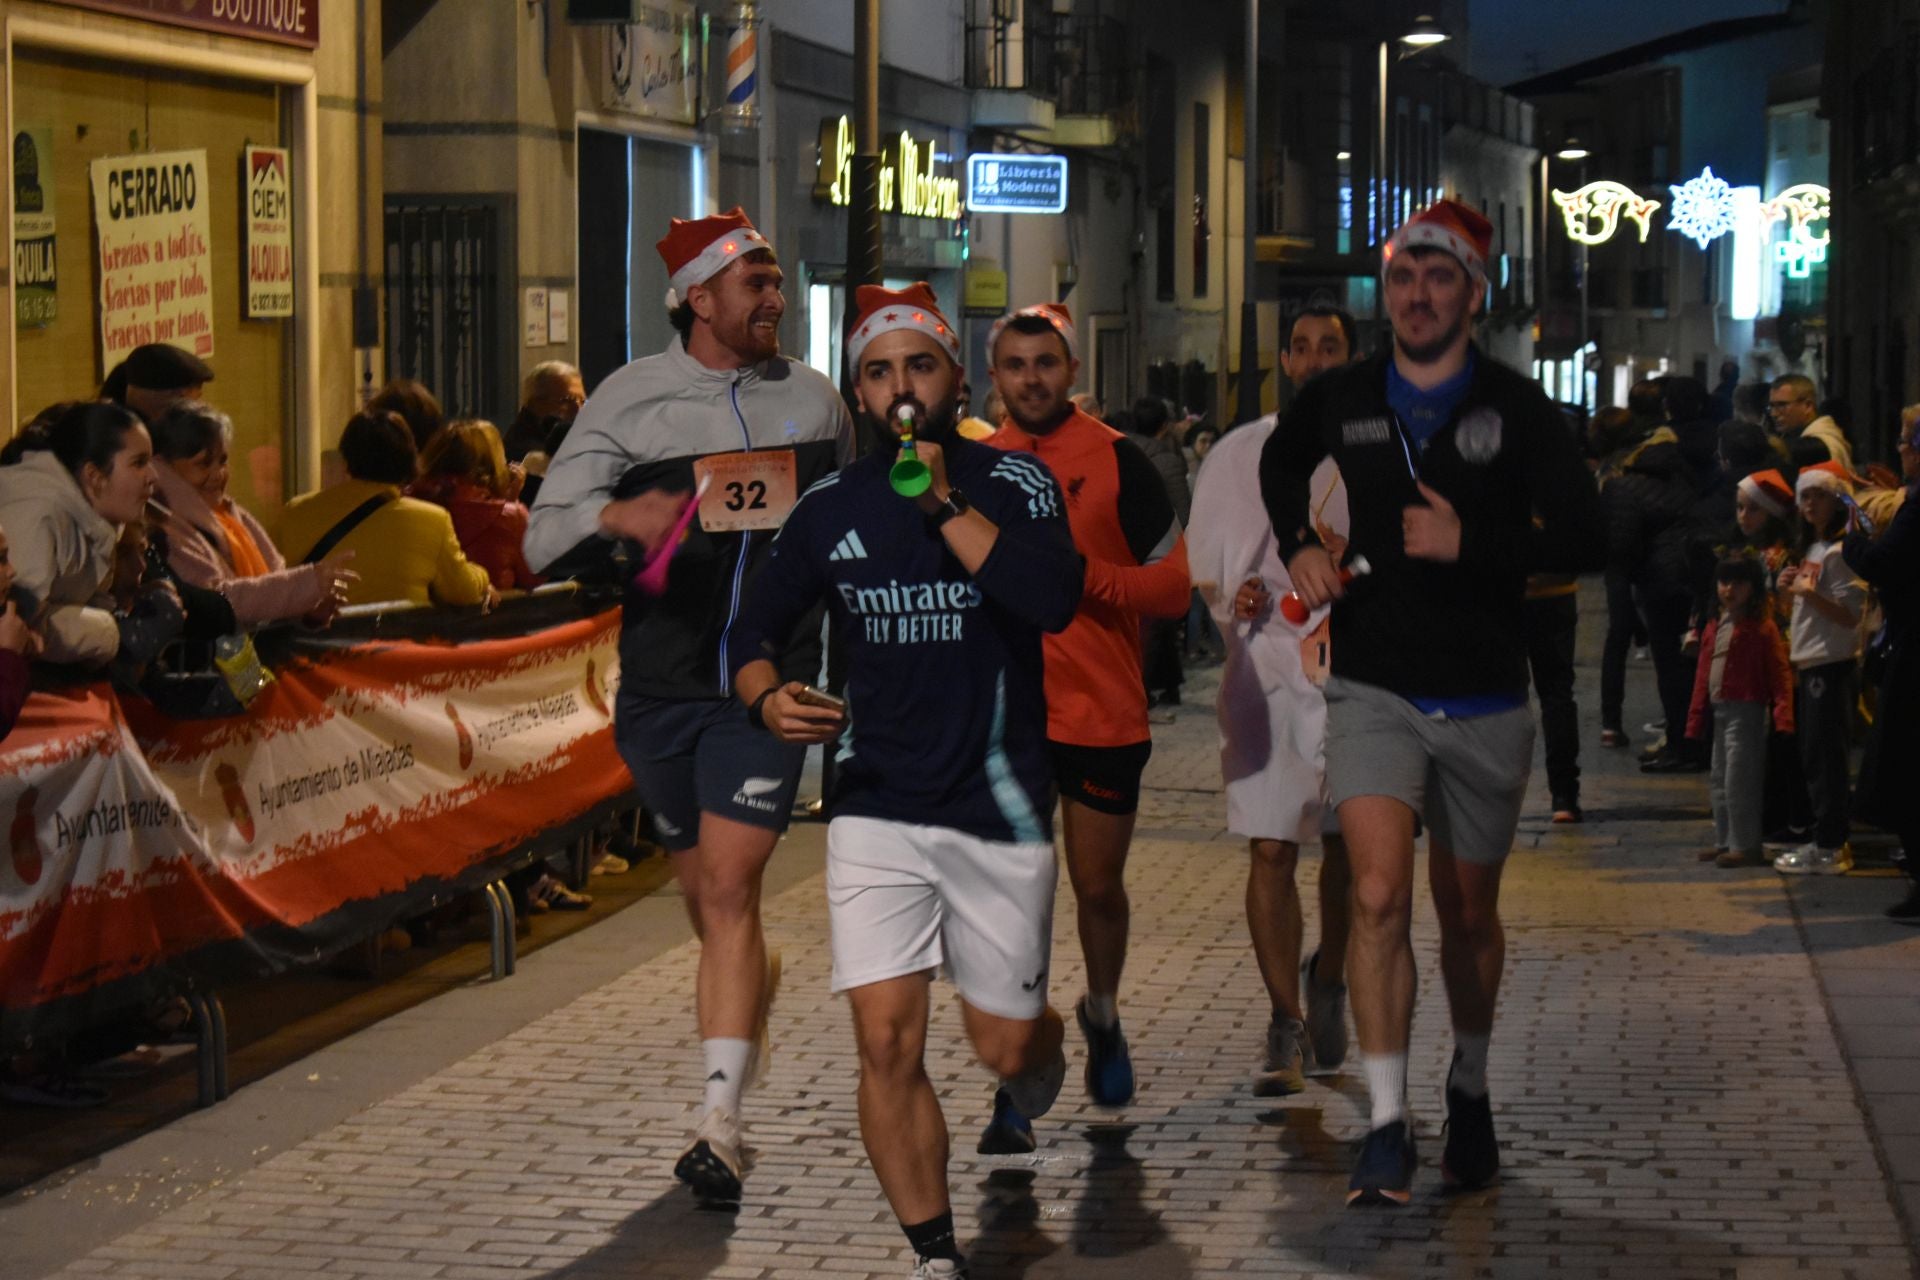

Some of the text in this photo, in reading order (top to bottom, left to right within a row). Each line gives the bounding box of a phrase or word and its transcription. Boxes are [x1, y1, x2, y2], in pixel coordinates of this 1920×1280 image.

[108, 163, 196, 221] CERRADO
[252, 188, 286, 220] CIEM
[1001, 180, 1057, 194] Moderna
[103, 233, 149, 272] Gracias
[155, 240, 164, 262] a
[250, 243, 290, 283] ALQUILA
[154, 278, 177, 315] por
[154, 317, 175, 344] por
[725, 480, 767, 512] 32
[837, 578, 983, 615] Emirates
[865, 613, 963, 645] FLY BETTER
[258, 739, 416, 821] Ayuntamiento de Miajadas
